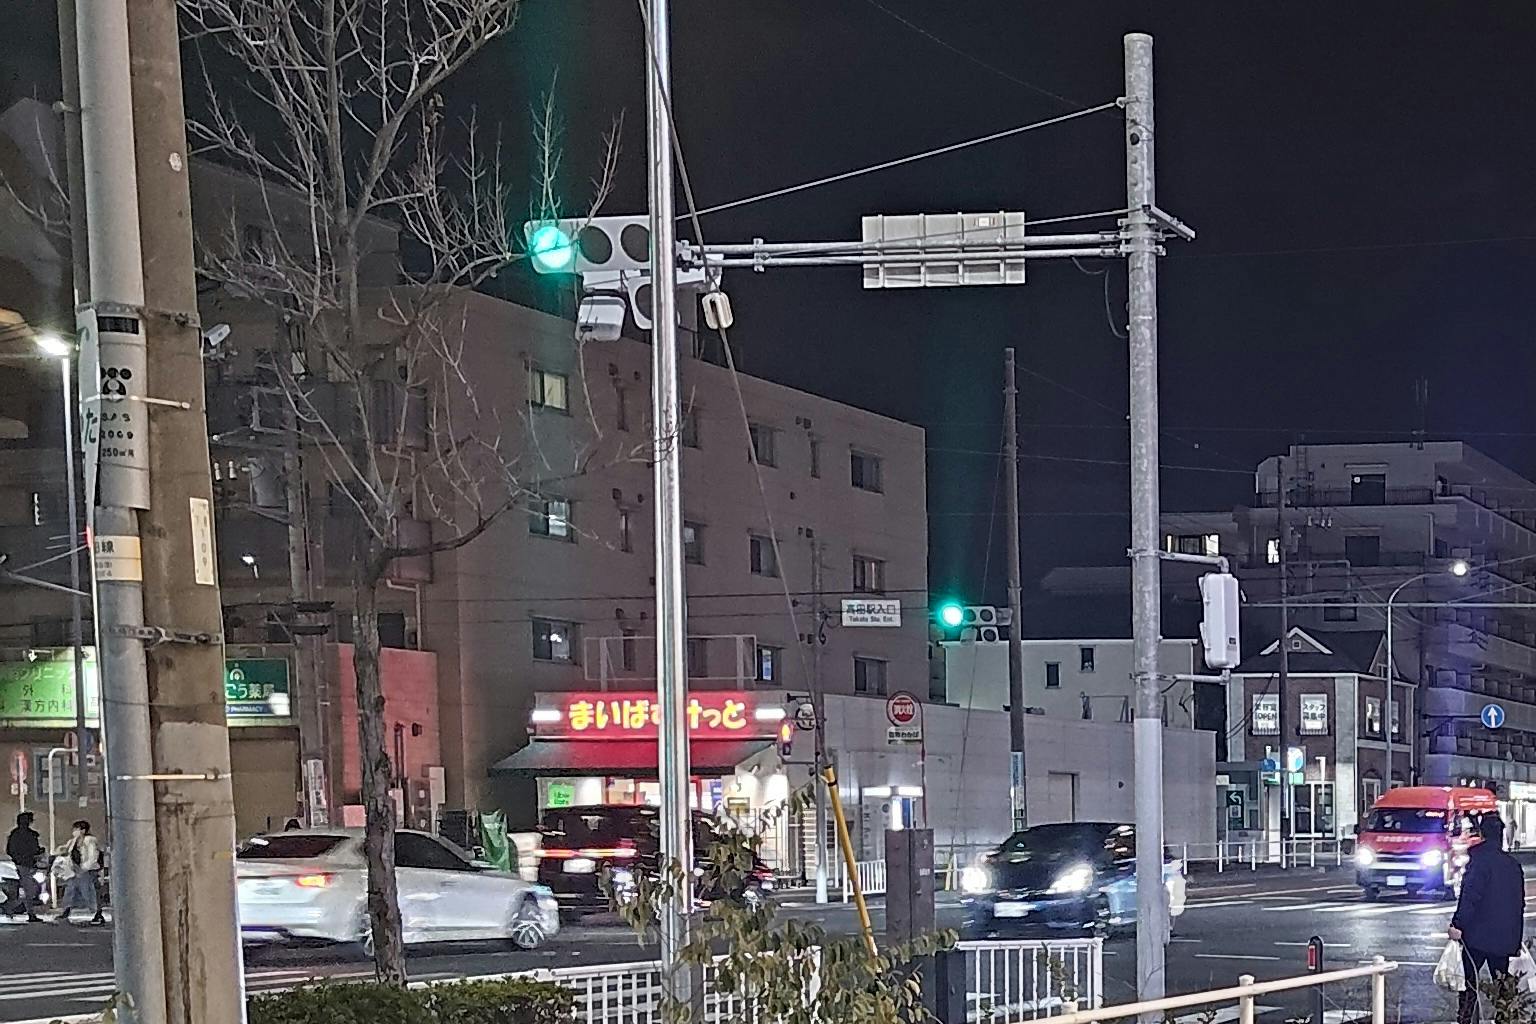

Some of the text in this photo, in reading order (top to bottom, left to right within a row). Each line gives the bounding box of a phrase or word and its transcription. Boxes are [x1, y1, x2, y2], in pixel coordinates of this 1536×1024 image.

[568, 700, 747, 730] まいばけっと
